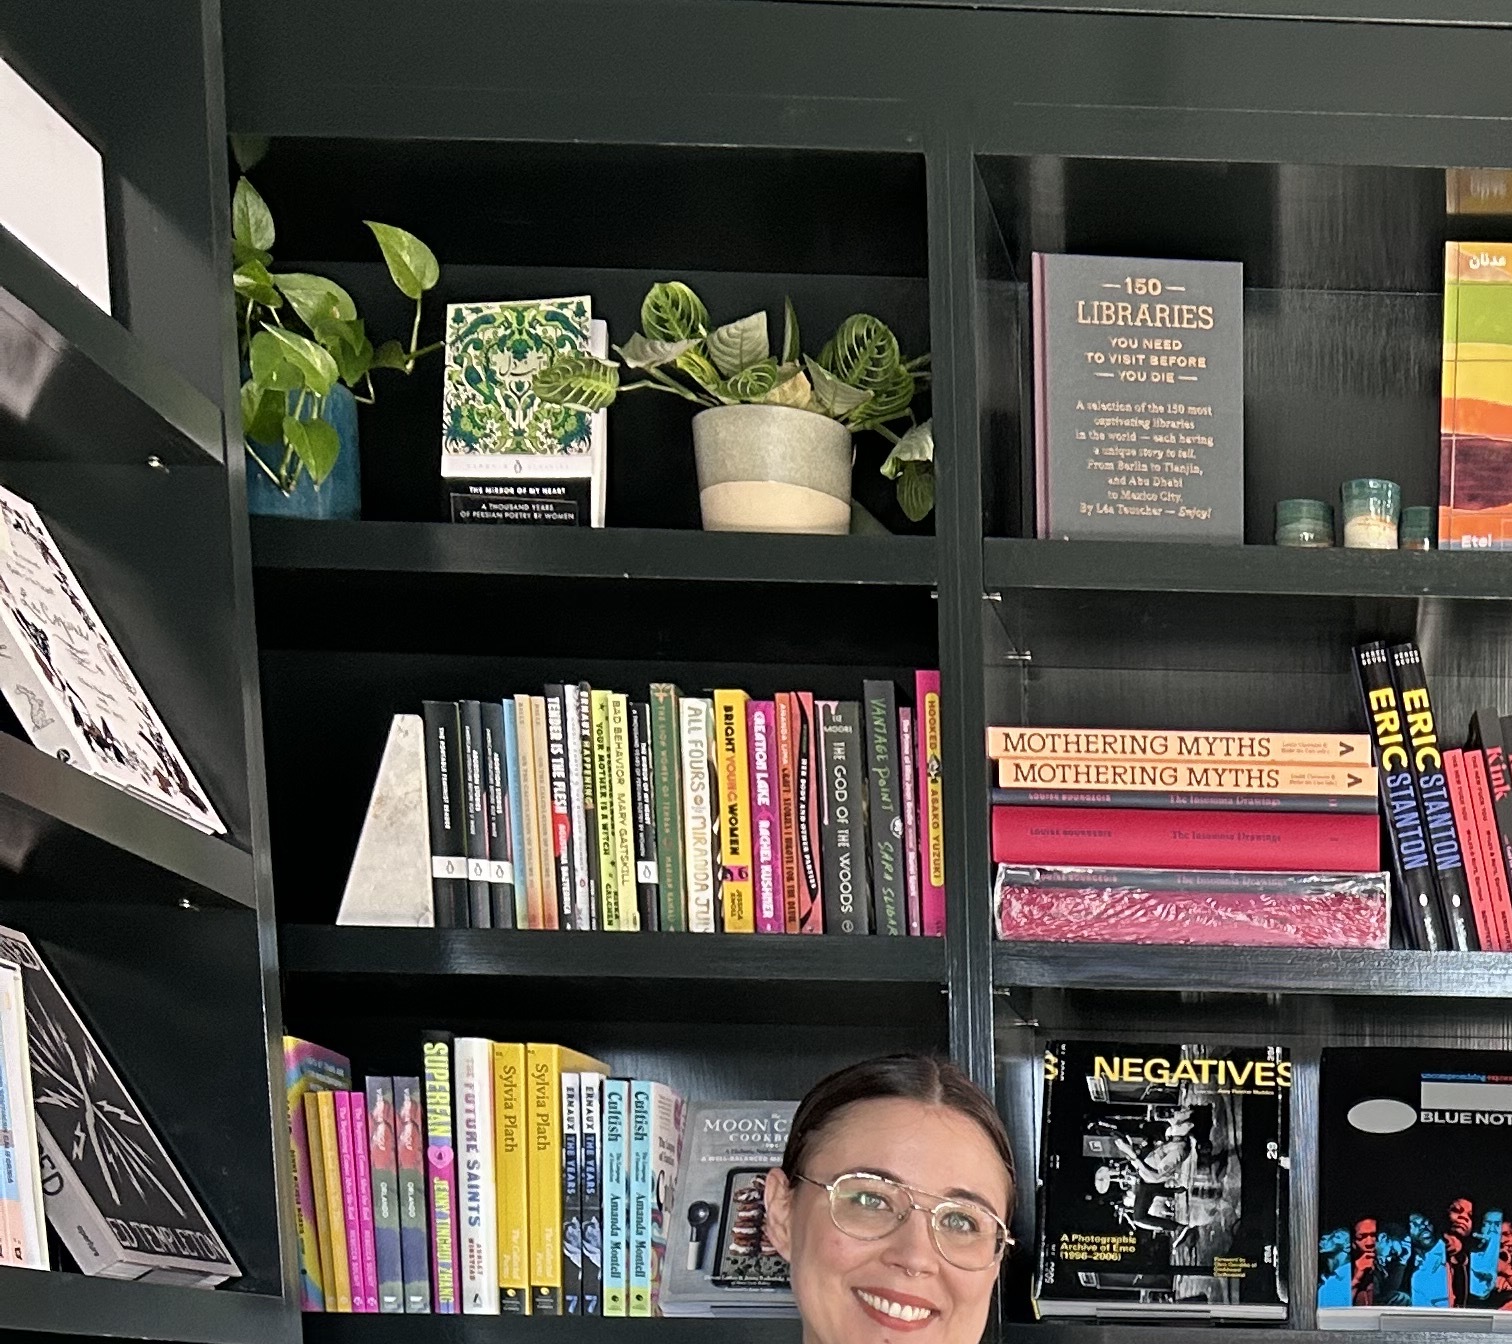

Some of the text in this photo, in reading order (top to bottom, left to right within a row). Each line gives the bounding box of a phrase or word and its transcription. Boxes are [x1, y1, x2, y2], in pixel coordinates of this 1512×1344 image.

[1469, 254, 1506, 268] عدنان
[1125, 278, 1162, 295] 150
[1077, 301, 1214, 329] LIBRARIES
[1110, 338, 1182, 350] YOU NEED
[1086, 353, 1206, 368] TO VISIT BEFORE
[1120, 372, 1175, 382] YOU DIE
[1462, 535, 1492, 548] Etel
[688, 706, 705, 791] ALL FOURS
[1003, 732, 1168, 754] MOTHERING
[1177, 736, 1271, 757] MYTHS
[723, 705, 740, 856] BRIGHT YOUNG WOMEN
[1013, 763, 1178, 785] MOTHERING
[1187, 766, 1279, 787] MYTHS
[1369, 687, 1429, 871] ERIC STANTON
[1402, 688, 1461, 871] ERIC STANTON
[1486, 747, 1510, 801] Kink
[928, 701, 942, 879] HOOKED ASAKO YUZUKI
[833, 742, 853, 914] THE GOD OF THE WOODS
[1094, 1056, 1291, 1086] NEGATIVES
[499, 1064, 517, 1153] Sylvia Plath
[1421, 1111, 1473, 1125] BLUE
[608, 1092, 623, 1279] Cultish Amanda Montell
[1060, 1234, 1136, 1245] A Photographic
[1060, 1243, 1098, 1251] Archive
[1113, 1244, 1135, 1253] Emo
